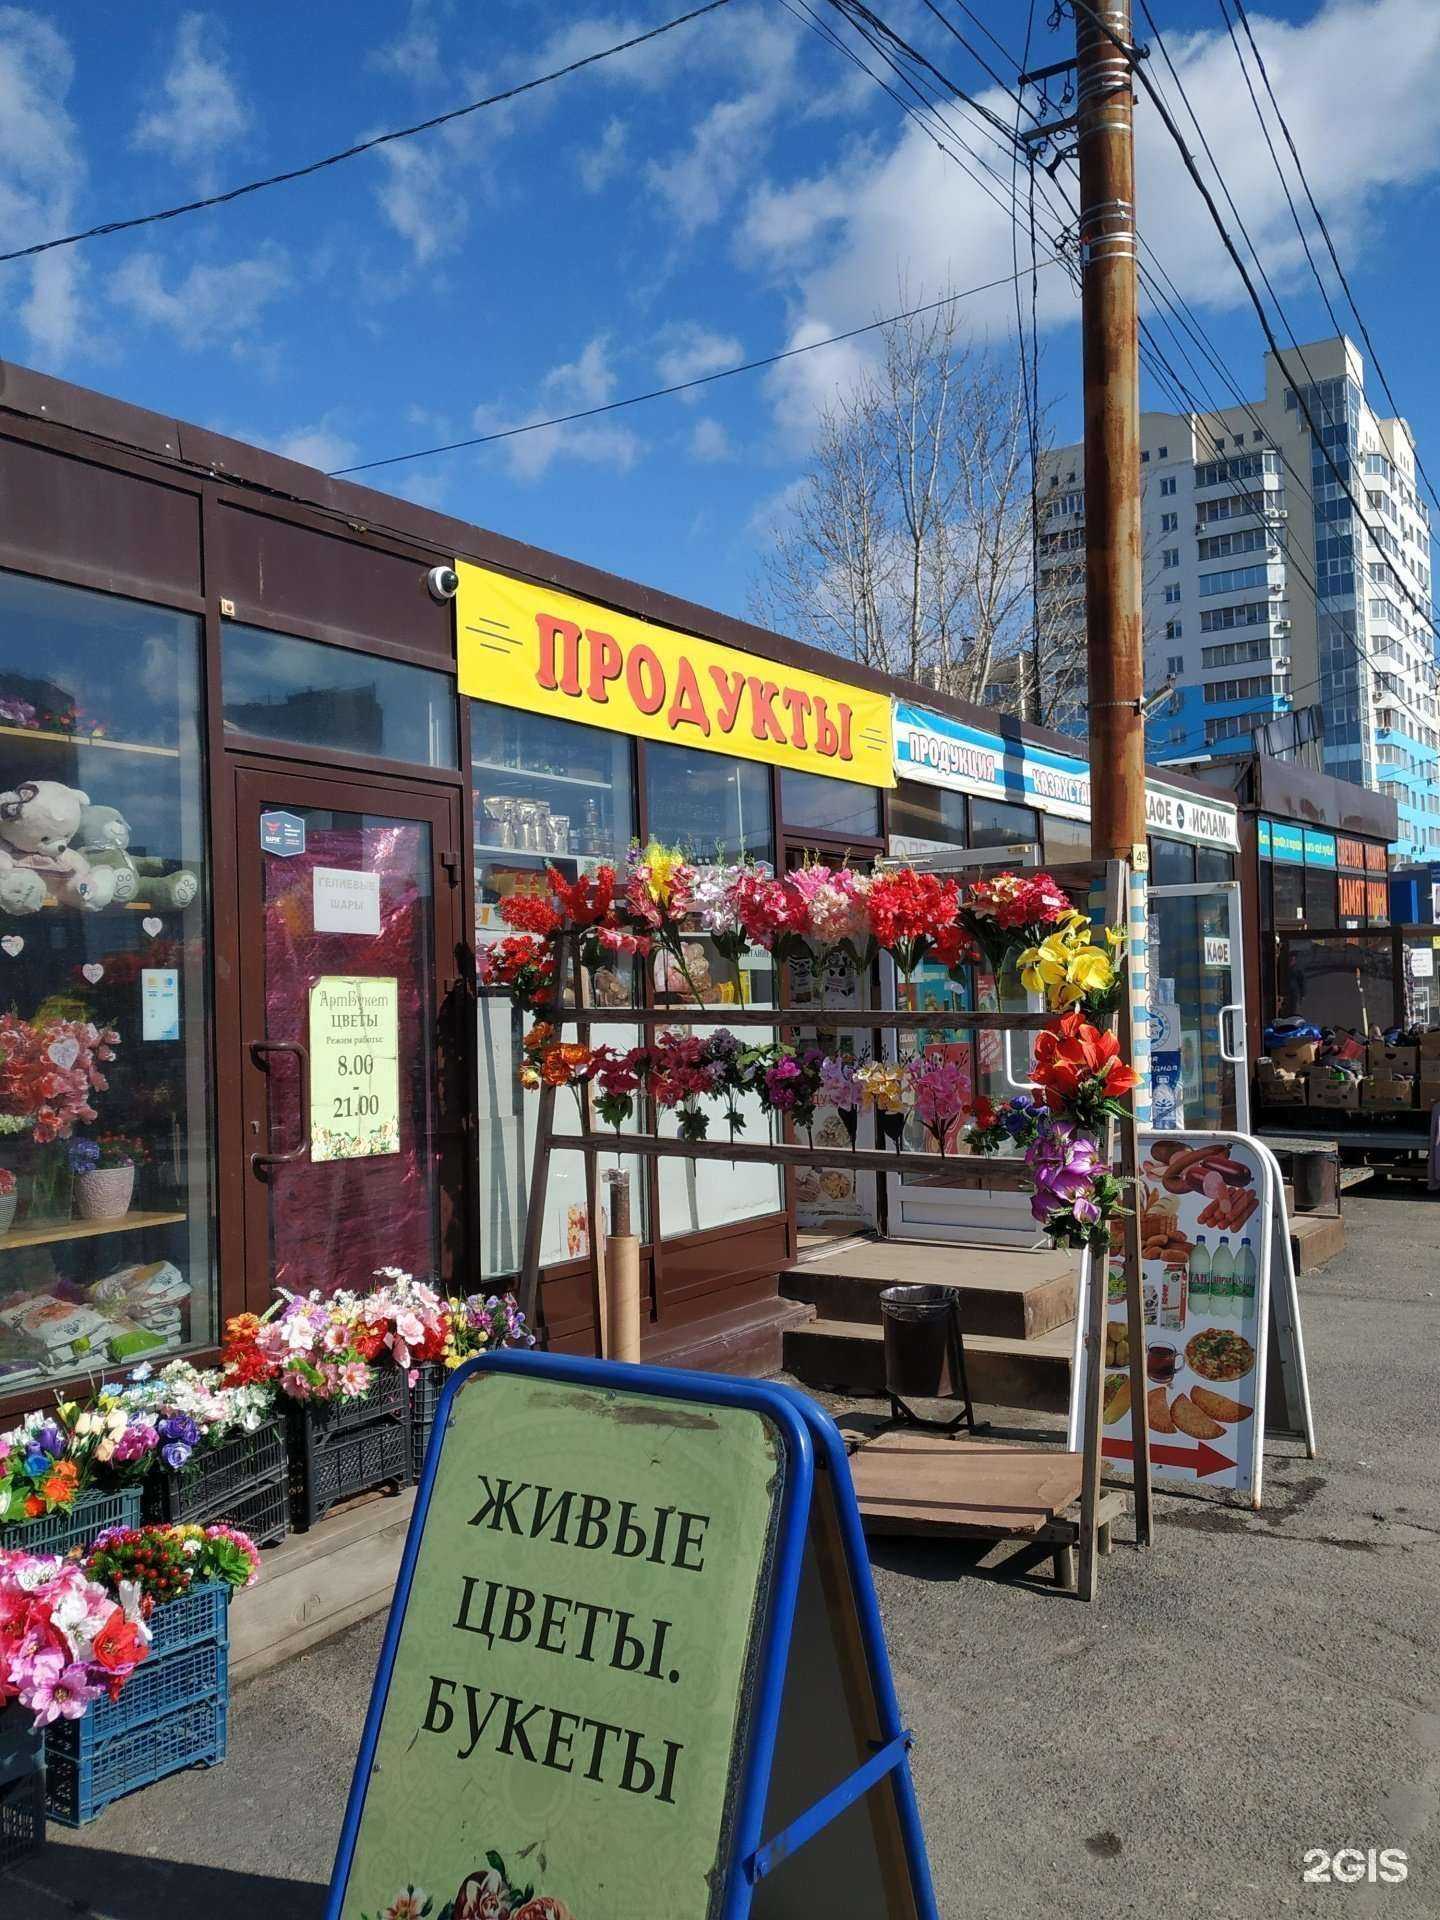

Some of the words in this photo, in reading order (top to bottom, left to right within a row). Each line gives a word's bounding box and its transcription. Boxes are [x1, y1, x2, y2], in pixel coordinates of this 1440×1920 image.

[535, 612, 853, 761] ПРОДУКТЫ
[908, 732, 995, 783] ПРОДУКЦИЯ
[330, 898, 365, 912] ШАРЫ
[1206, 941, 1228, 962] КАФЕ
[331, 1014, 378, 1030] ЦВЕТЫ
[326, 1035, 352, 1045] Режим
[338, 1054, 374, 1076] 8.00
[333, 1094, 379, 1118] 21.00
[467, 1474, 711, 1573] ЖИВЫЕ
[452, 1575, 681, 1684] ЦВЕТЫ.
[421, 1675, 685, 1805] БУКЕТЫ
